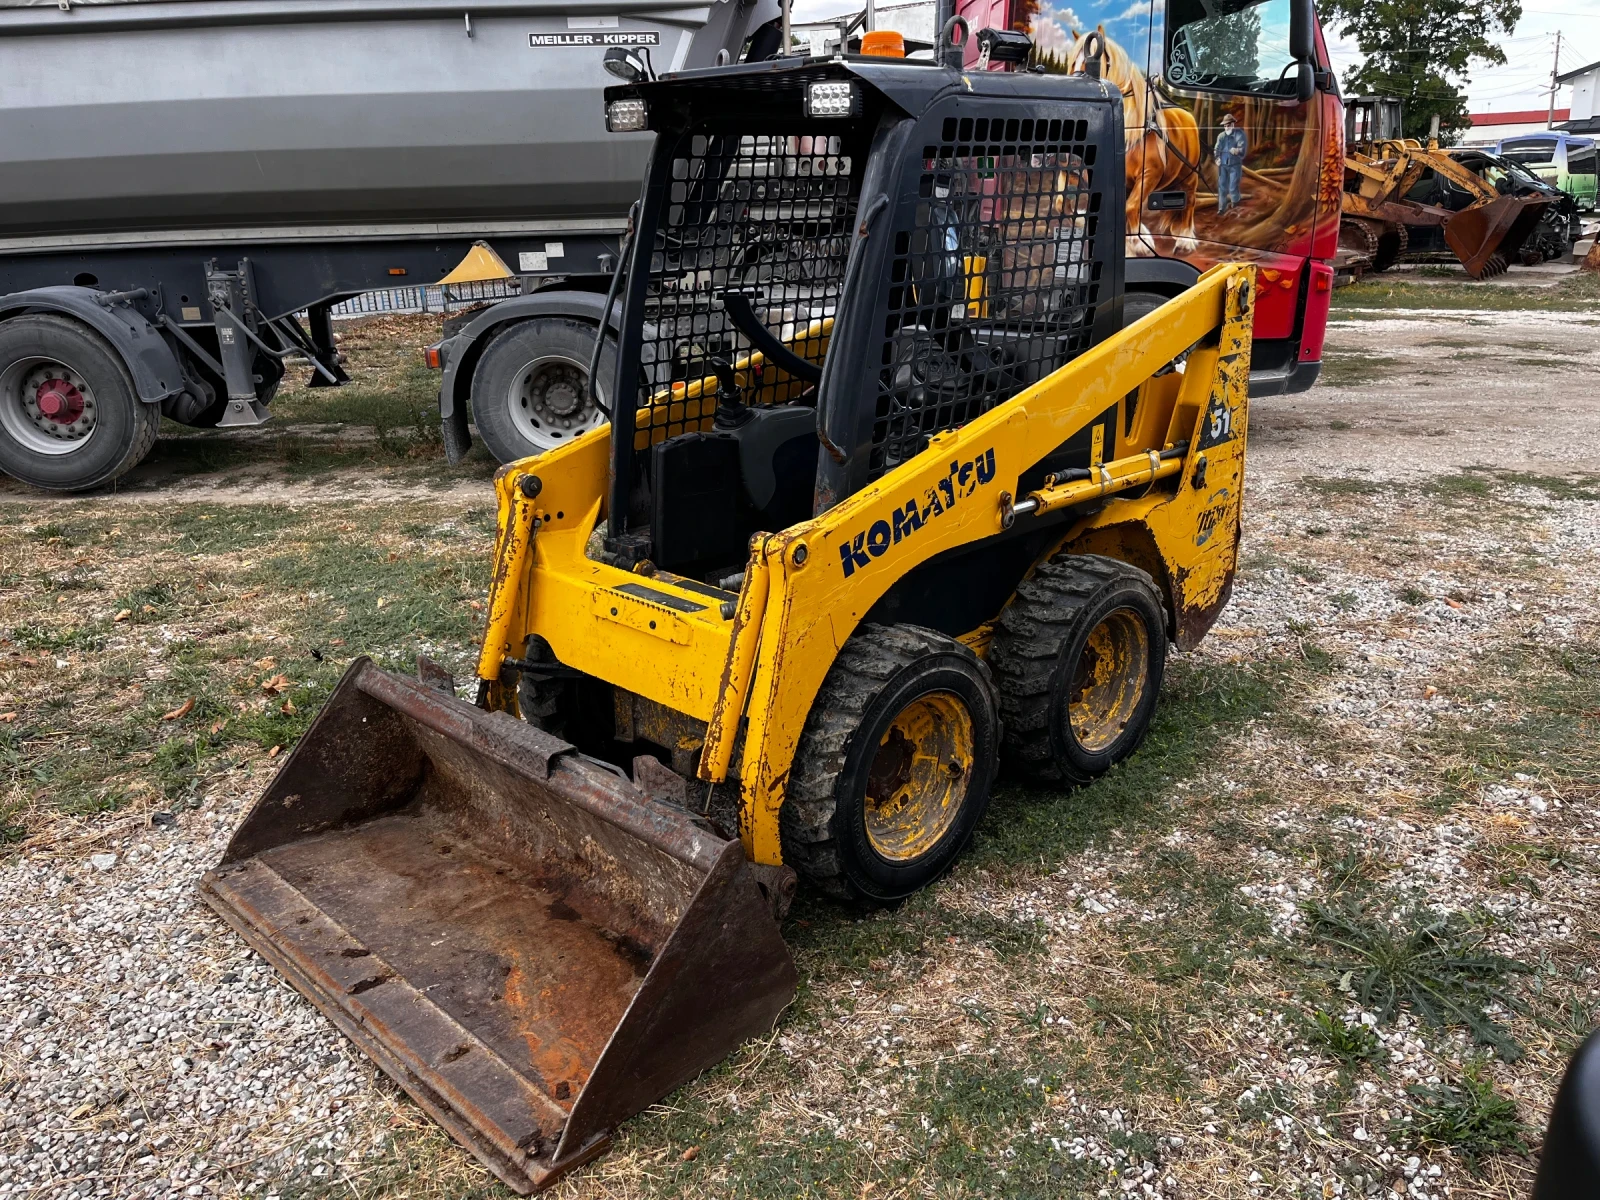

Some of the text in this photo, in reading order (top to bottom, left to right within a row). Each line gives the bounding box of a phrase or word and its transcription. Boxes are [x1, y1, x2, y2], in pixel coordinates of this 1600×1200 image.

[531, 35, 593, 45] MEILLER
[603, 34, 656, 44] KIPPER
[1210, 408, 1230, 440] 51
[838, 446, 997, 579] KOMATSU
